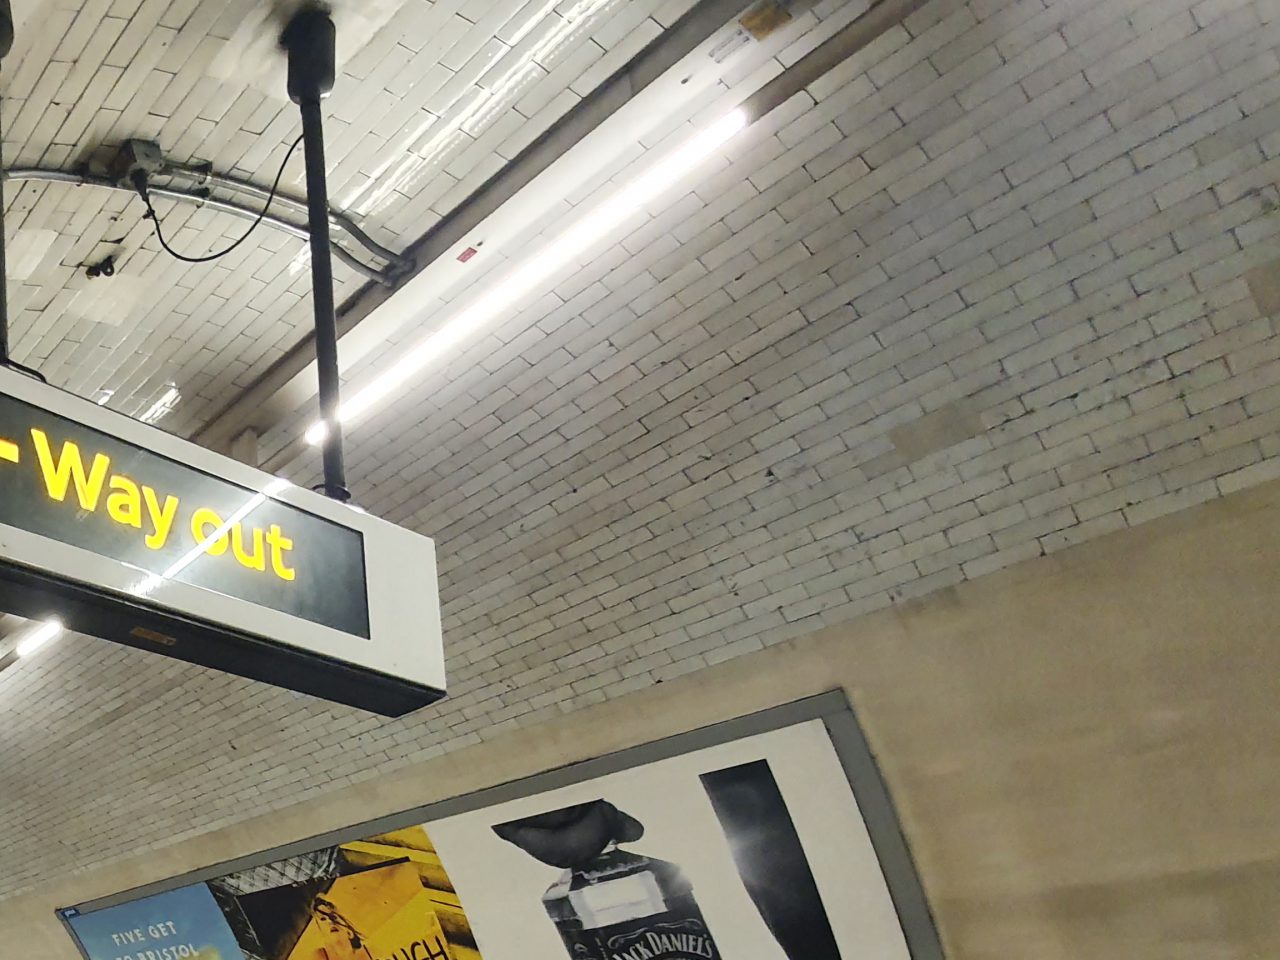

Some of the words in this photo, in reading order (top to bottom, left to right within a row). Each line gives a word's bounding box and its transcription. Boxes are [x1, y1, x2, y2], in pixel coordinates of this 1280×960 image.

[30, 428, 179, 550] Way
[190, 506, 296, 581] out
[111, 928, 145, 946] FIVE
[148, 920, 177, 938] GET
